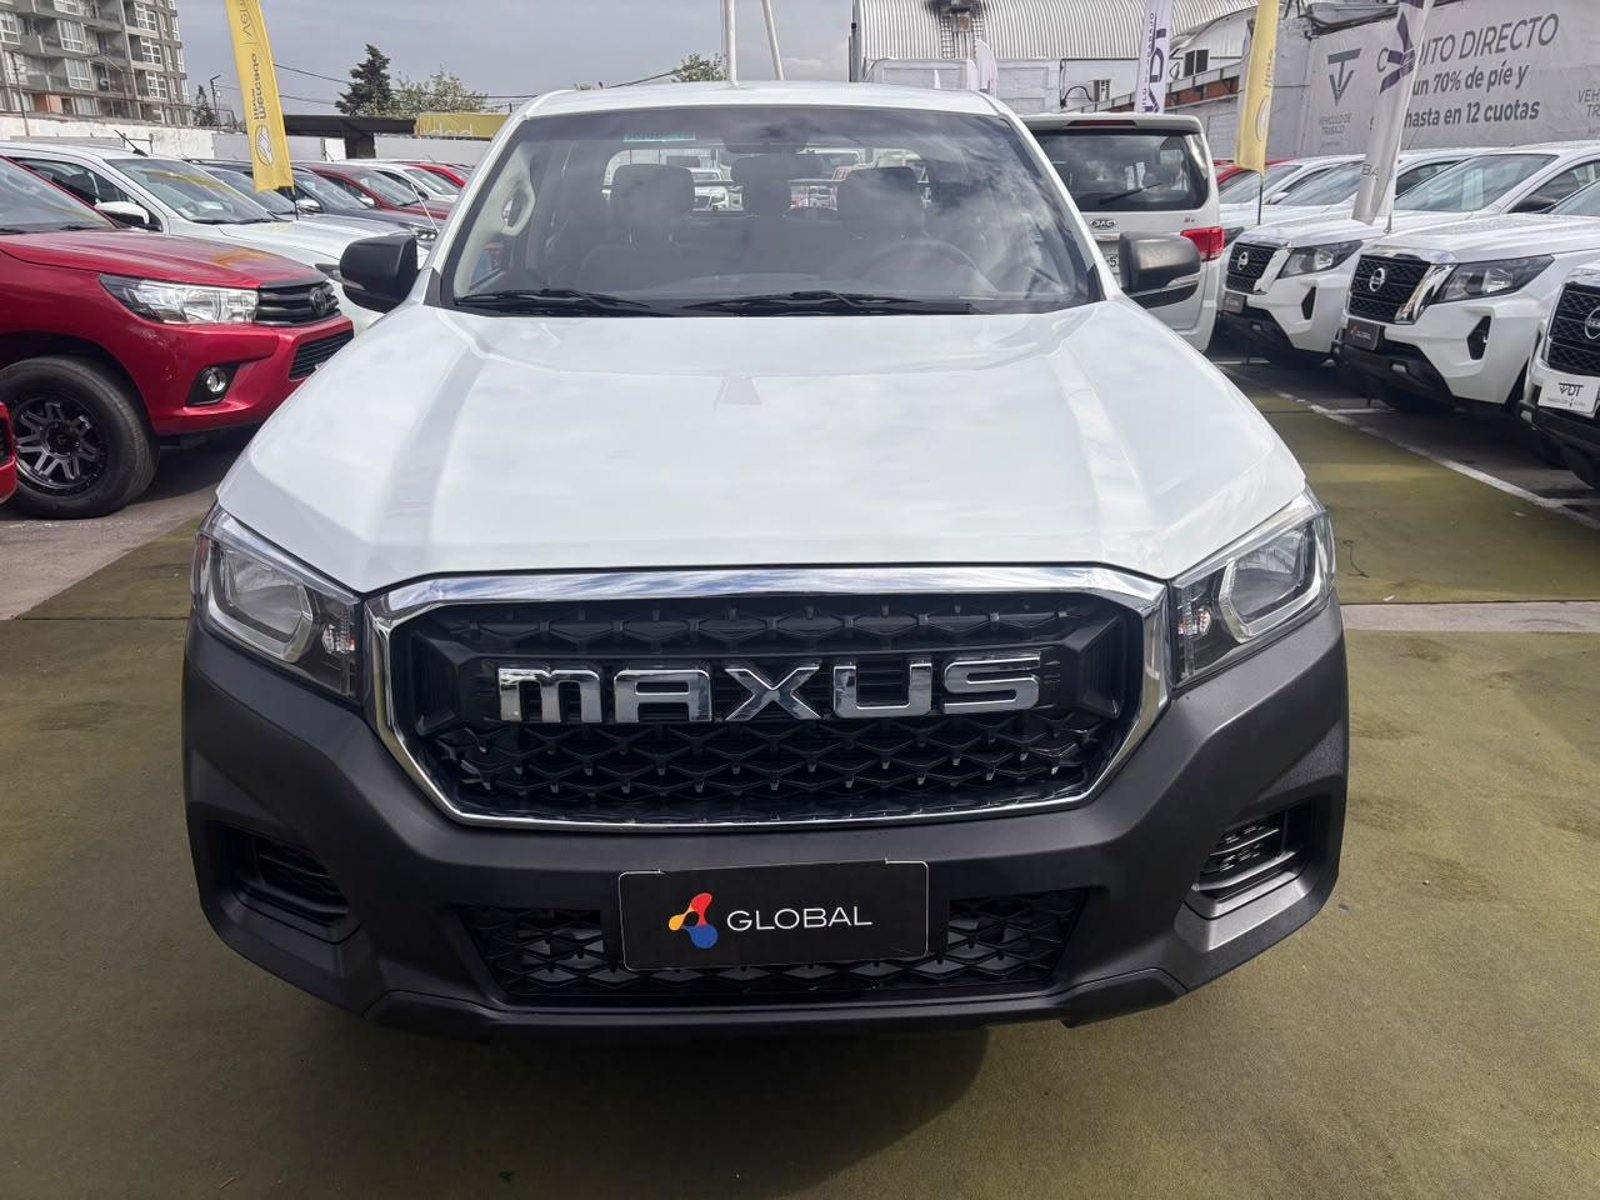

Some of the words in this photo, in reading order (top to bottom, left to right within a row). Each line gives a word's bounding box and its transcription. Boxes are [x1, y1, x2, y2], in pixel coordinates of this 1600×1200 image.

[1459, 13, 1559, 60] DIRECTO
[1433, 69, 1462, 94] 70%
[1465, 65, 1484, 90] de
[1515, 64, 1530, 90] y
[1404, 107, 1440, 128] hasta
[1444, 106, 1462, 125] en
[1466, 101, 1481, 124] 12
[1484, 99, 1541, 122] cuotas
[498, 655, 1041, 724] MAXUS
[726, 905, 874, 932] GLOBAL
